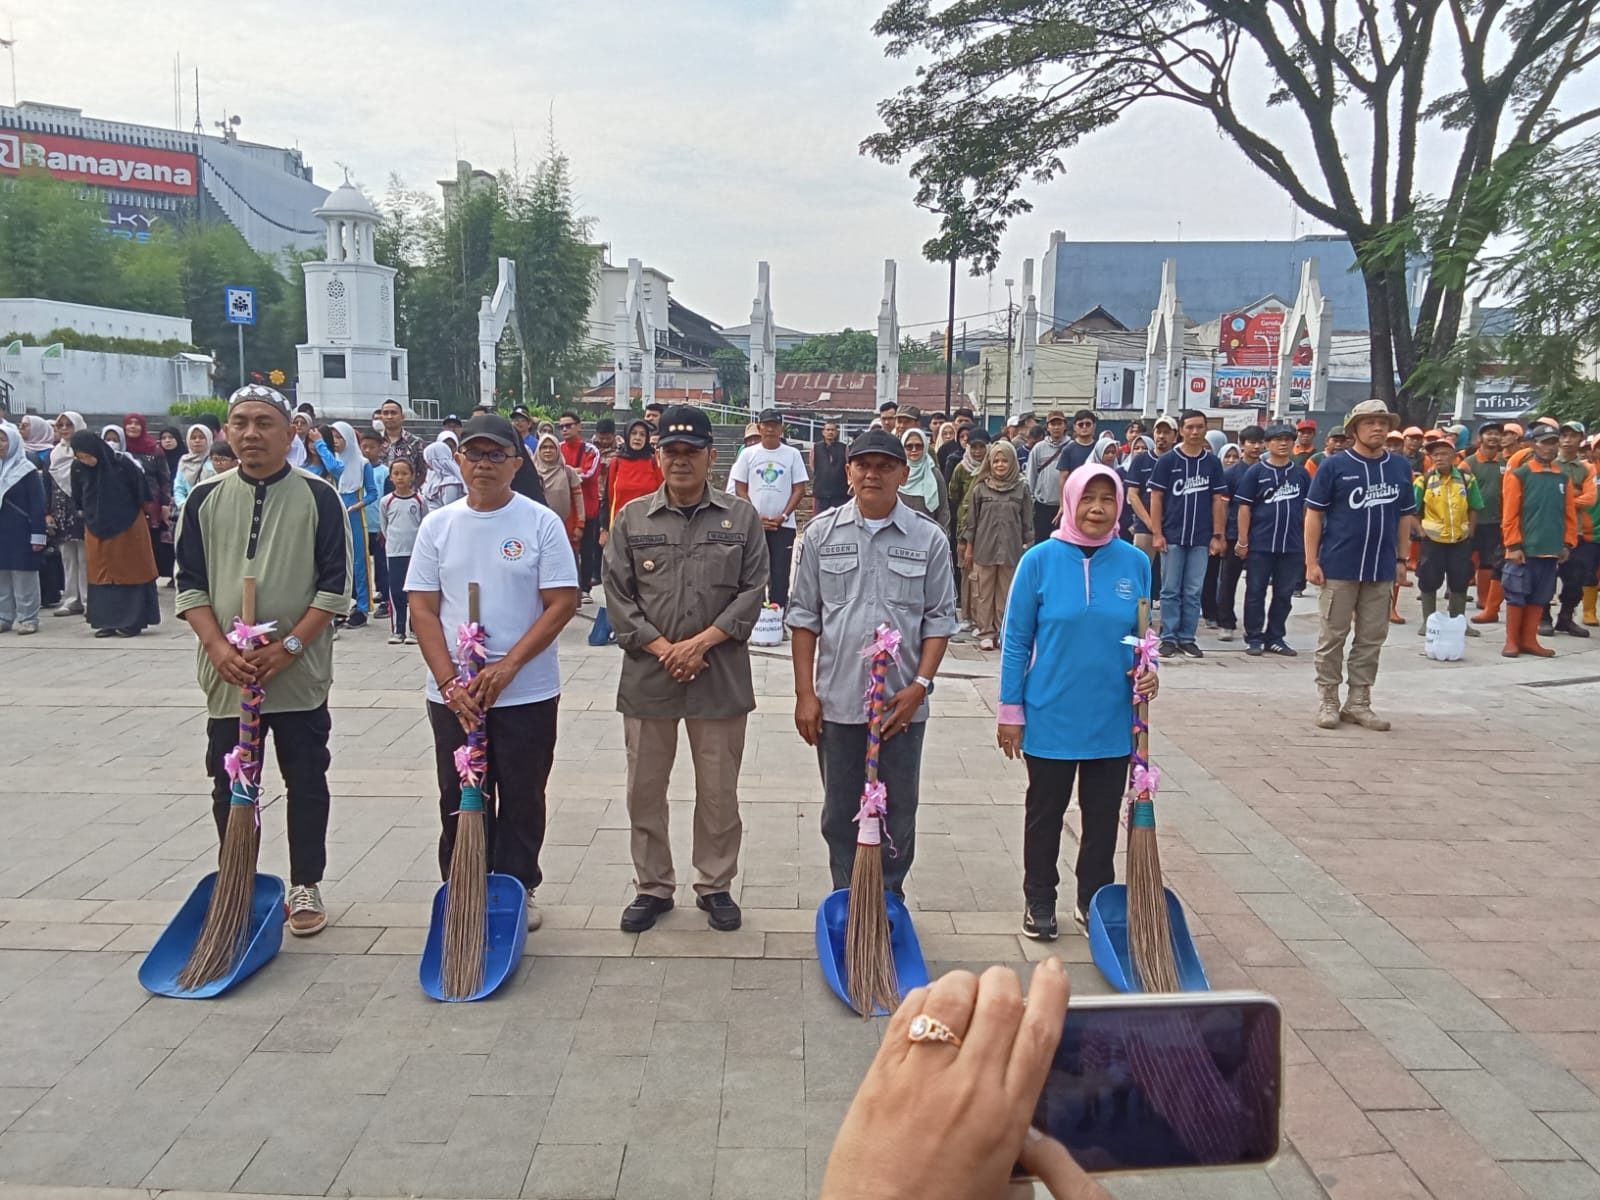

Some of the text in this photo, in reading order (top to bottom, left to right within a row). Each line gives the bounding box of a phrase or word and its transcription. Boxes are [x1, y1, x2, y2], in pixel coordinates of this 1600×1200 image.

[22, 142, 192, 186] Ramayana
[1217, 377, 1267, 389] GARUDA
[1475, 394, 1531, 408] nfinix
[1349, 484, 1400, 510] Cimahi
[895, 549, 921, 559] LURAH
